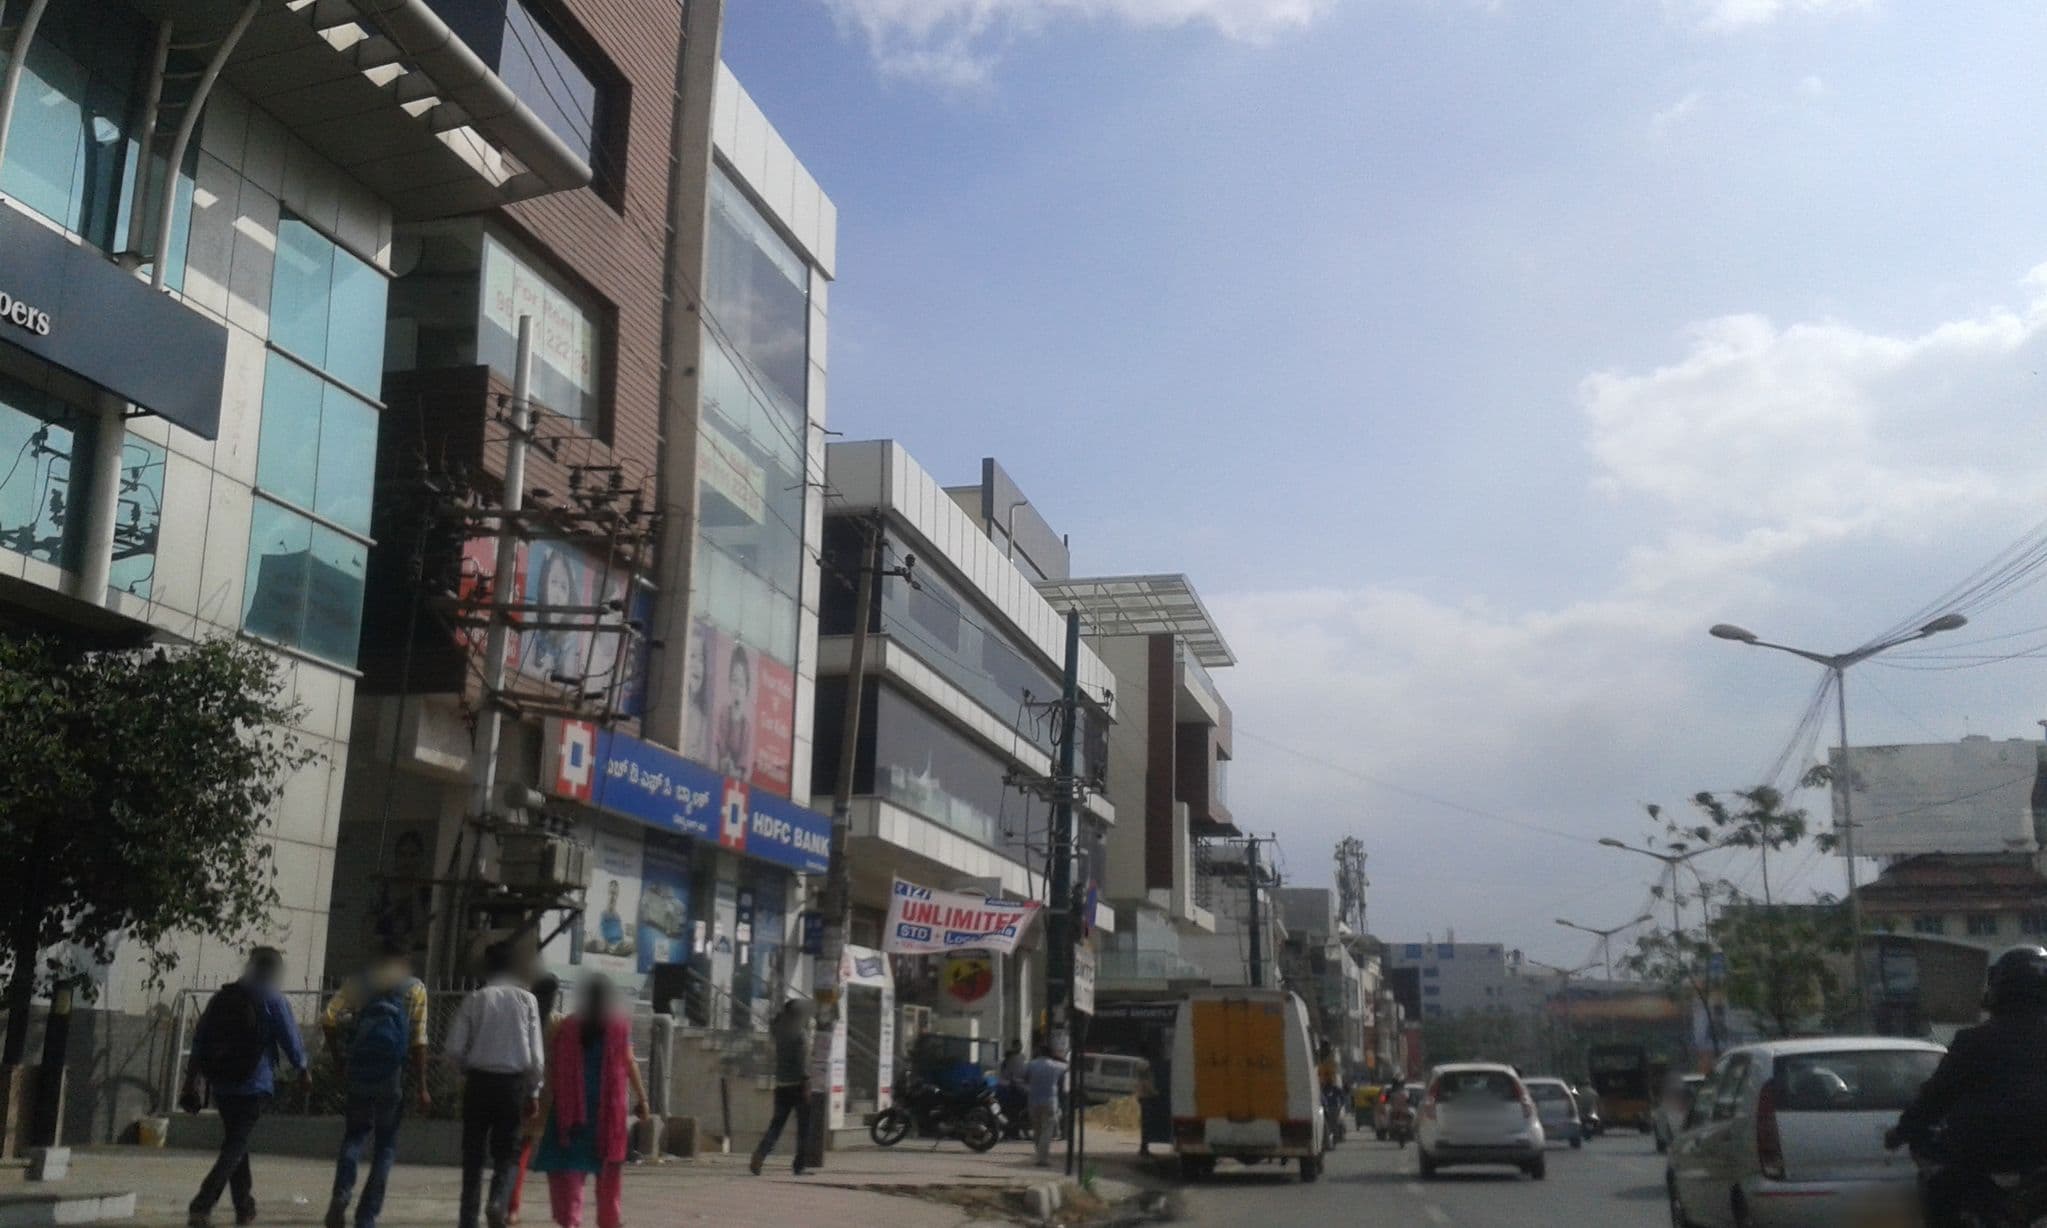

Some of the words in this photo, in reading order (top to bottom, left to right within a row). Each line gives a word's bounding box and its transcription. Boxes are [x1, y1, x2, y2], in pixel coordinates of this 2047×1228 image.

[752, 811, 791, 845] HDFC
[793, 827, 830, 857] BANK
[900, 924, 929, 940] STD
